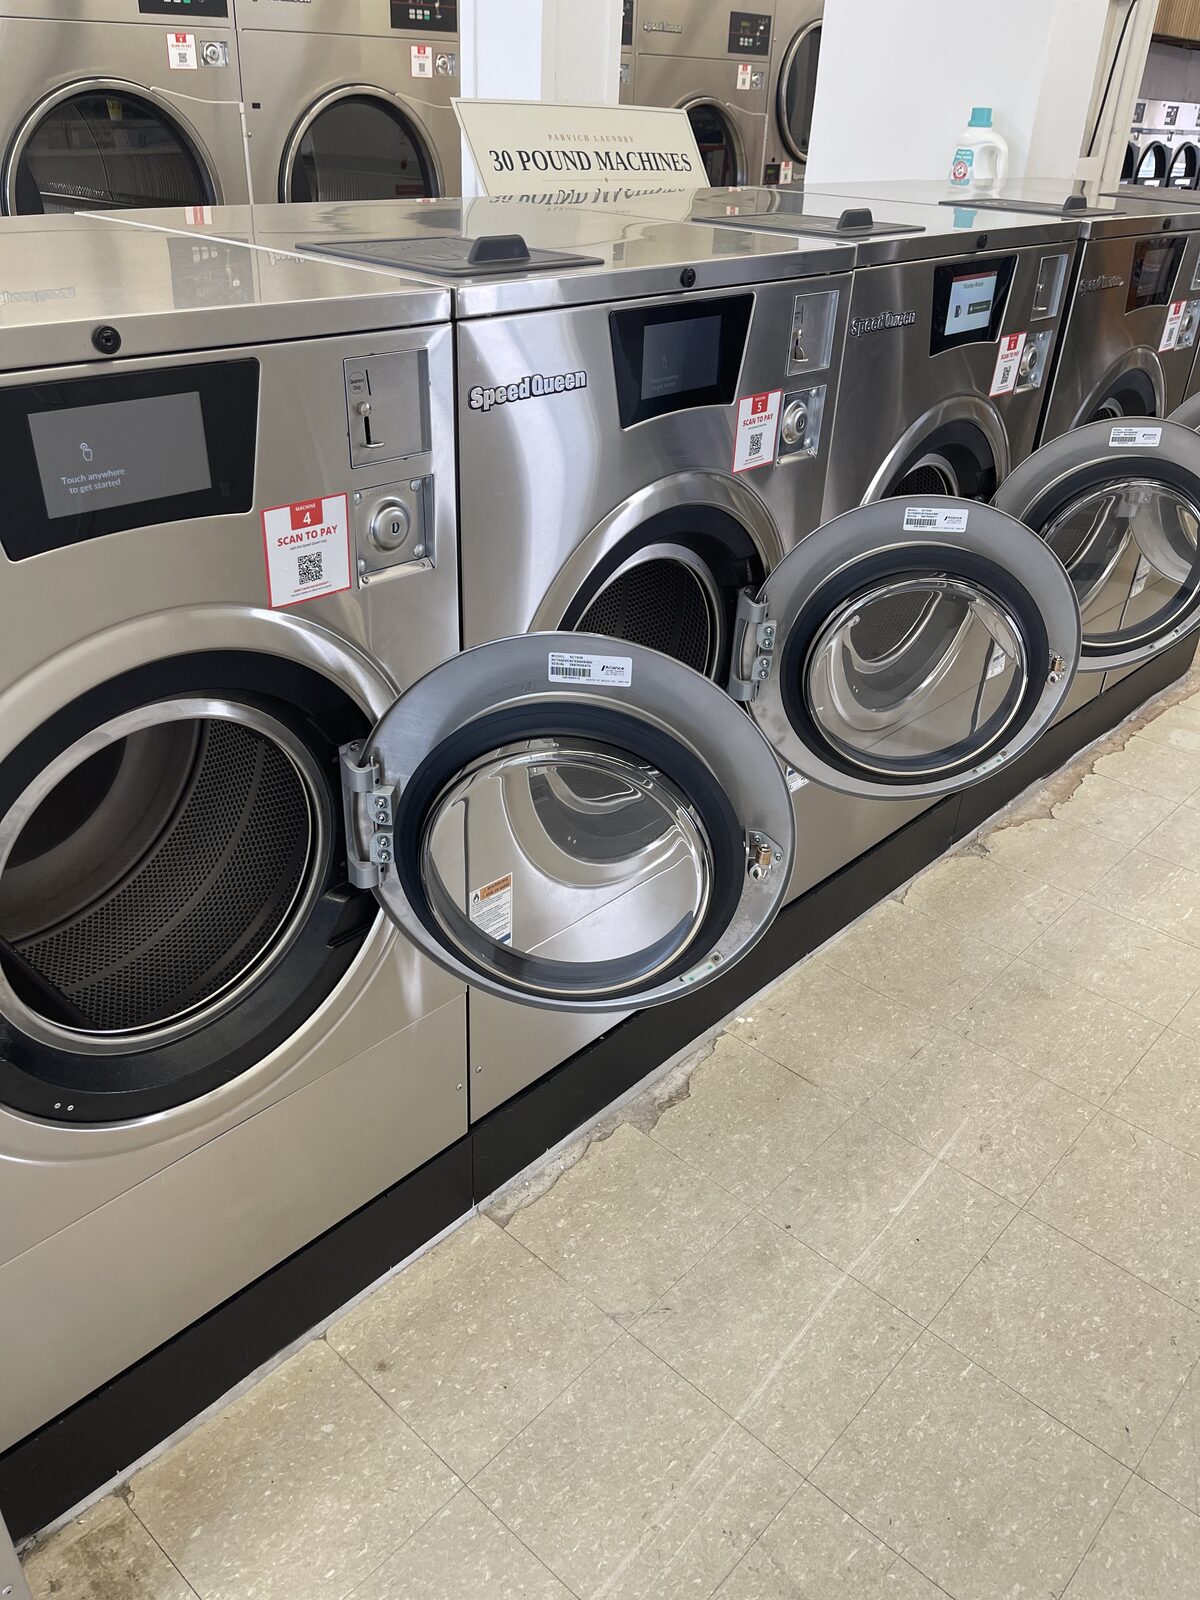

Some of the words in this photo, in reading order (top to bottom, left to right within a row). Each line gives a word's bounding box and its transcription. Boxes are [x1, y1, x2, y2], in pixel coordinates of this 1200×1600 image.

[593, 135, 634, 143] LAUNDRY
[489, 150, 514, 171] 30
[516, 150, 591, 171] POUND
[594, 151, 692, 172] MACHINES
[851, 313, 886, 338] Speed
[884, 311, 916, 329] Queen
[468, 377, 532, 412] Speed
[531, 370, 587, 396] Queen
[757, 401, 762, 412] 5
[742, 418, 756, 427] SCAN
[757, 415, 763, 424] TO
[764, 413, 773, 421] PAY
[61, 474, 86, 485] Touch
[88, 468, 125, 481] anywhere
[80, 484, 92, 494] get
[95, 478, 121, 490] started
[295, 503, 316, 511] MACHINE
[303, 511, 312, 525] 4
[277, 532, 303, 547] SCAN
[305, 530, 318, 540] TO
[320, 524, 338, 537] PAY
